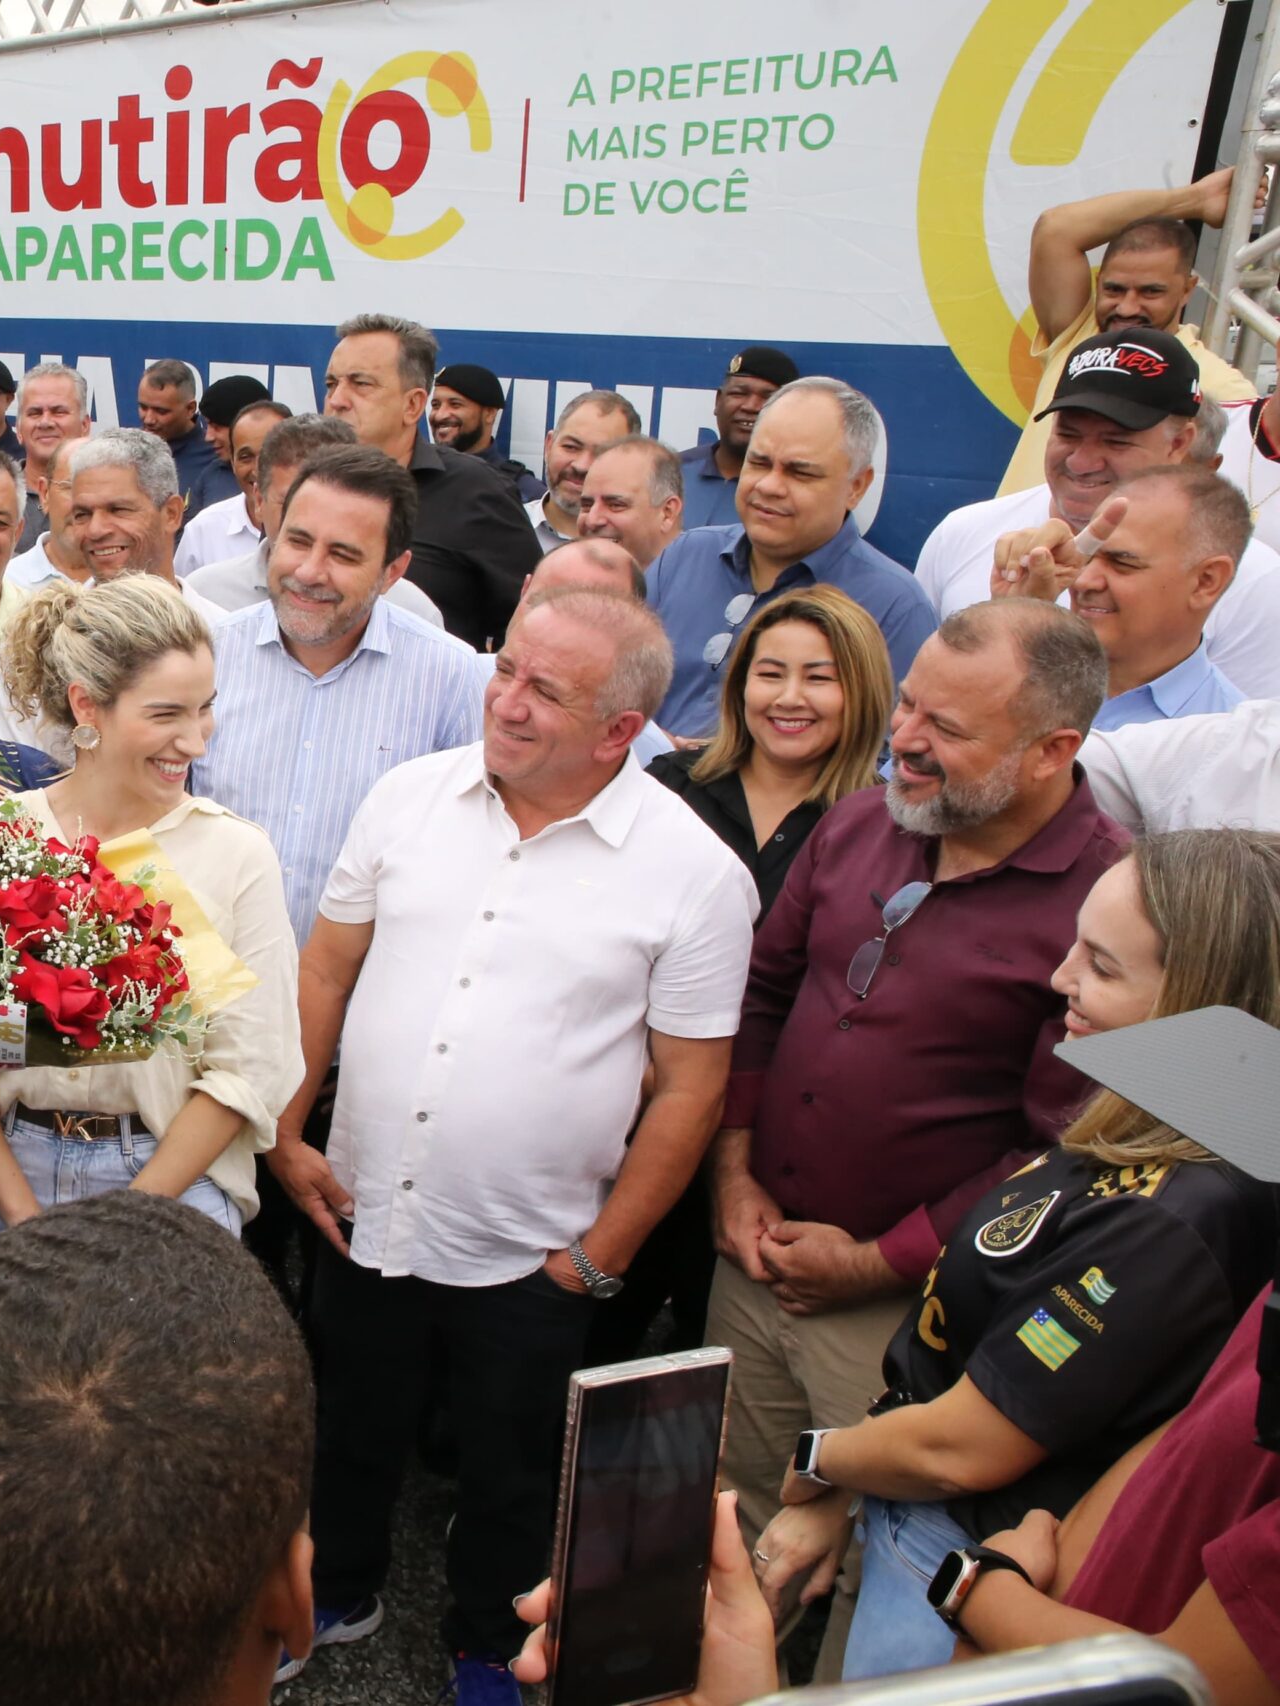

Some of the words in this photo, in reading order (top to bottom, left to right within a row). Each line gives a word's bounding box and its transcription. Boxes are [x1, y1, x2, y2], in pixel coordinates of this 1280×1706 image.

[569, 73, 597, 107] A
[609, 45, 899, 104] PREFEITURA
[566, 123, 667, 162] MAIS
[681, 113, 836, 156] PERTO
[563, 182, 617, 217] DE
[631, 168, 749, 215] VOCÊ
[1050, 1284, 1105, 1335] APARECIDA
